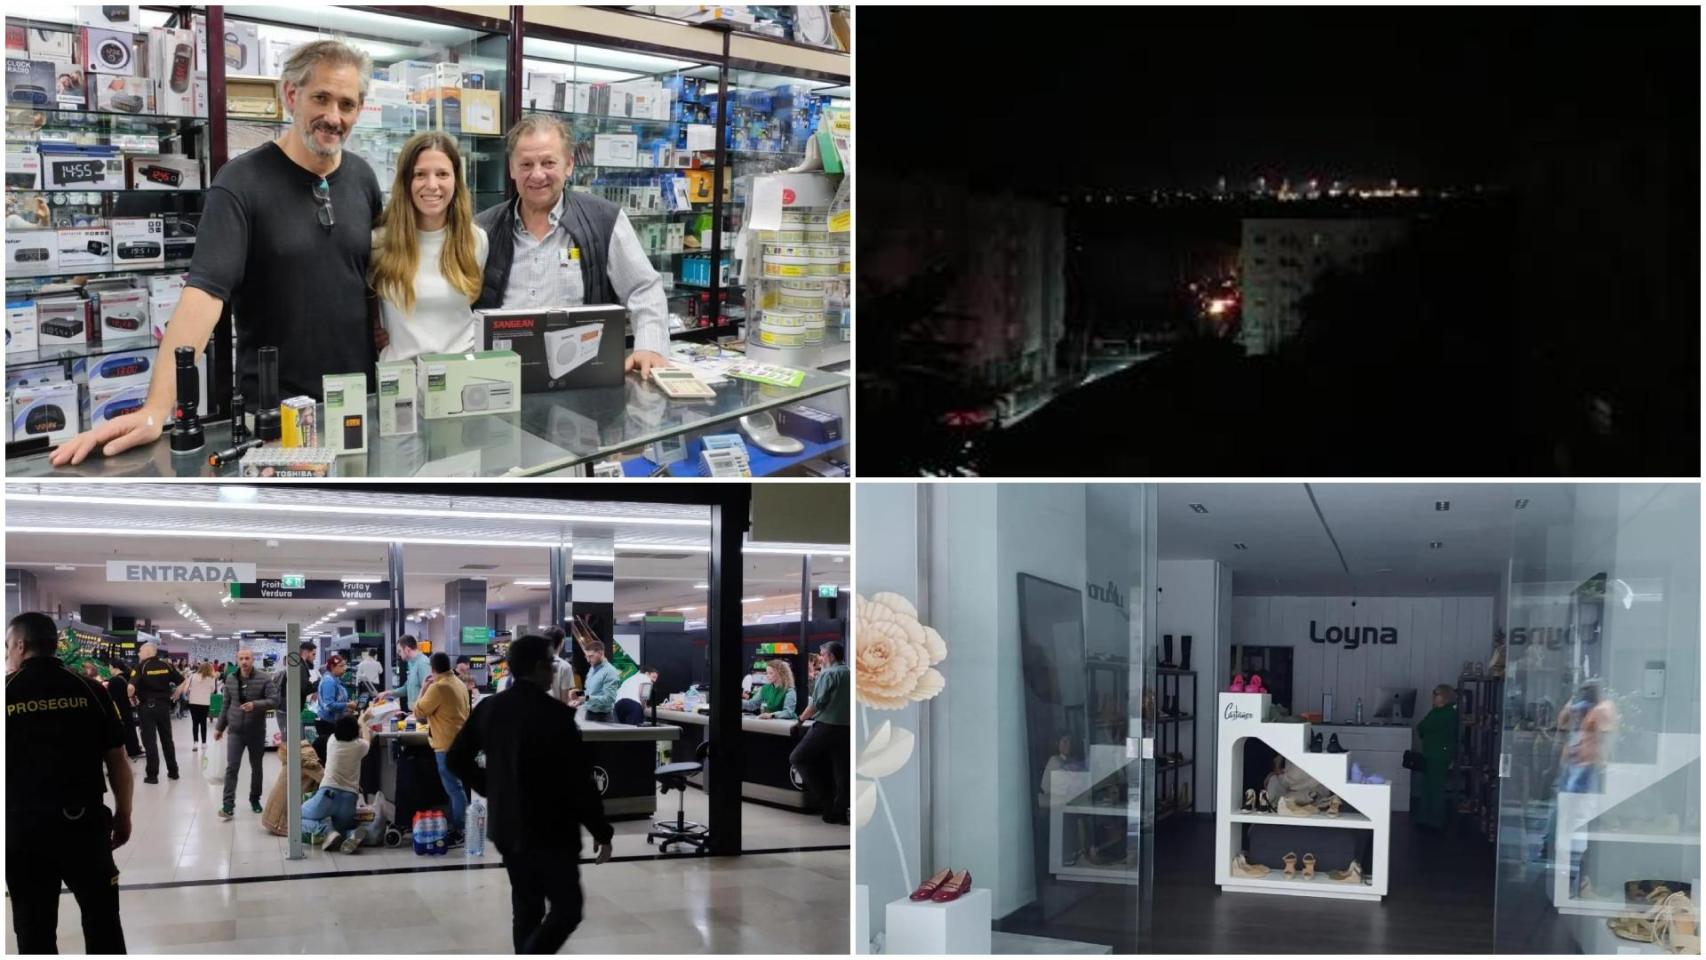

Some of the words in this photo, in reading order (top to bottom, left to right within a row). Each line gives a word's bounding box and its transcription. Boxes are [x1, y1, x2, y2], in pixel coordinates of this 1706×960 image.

[6, 60, 31, 68] CLOCK
[493, 320, 534, 329] SANGEAN
[125, 565, 239, 582] ENTRADA
[343, 582, 364, 590] Fruta
[365, 583, 371, 591] y
[261, 589, 293, 597] Verdura
[341, 590, 373, 598] Verdura
[1309, 620, 1398, 650] Loyna
[6, 697, 89, 717] PROSEGUR
